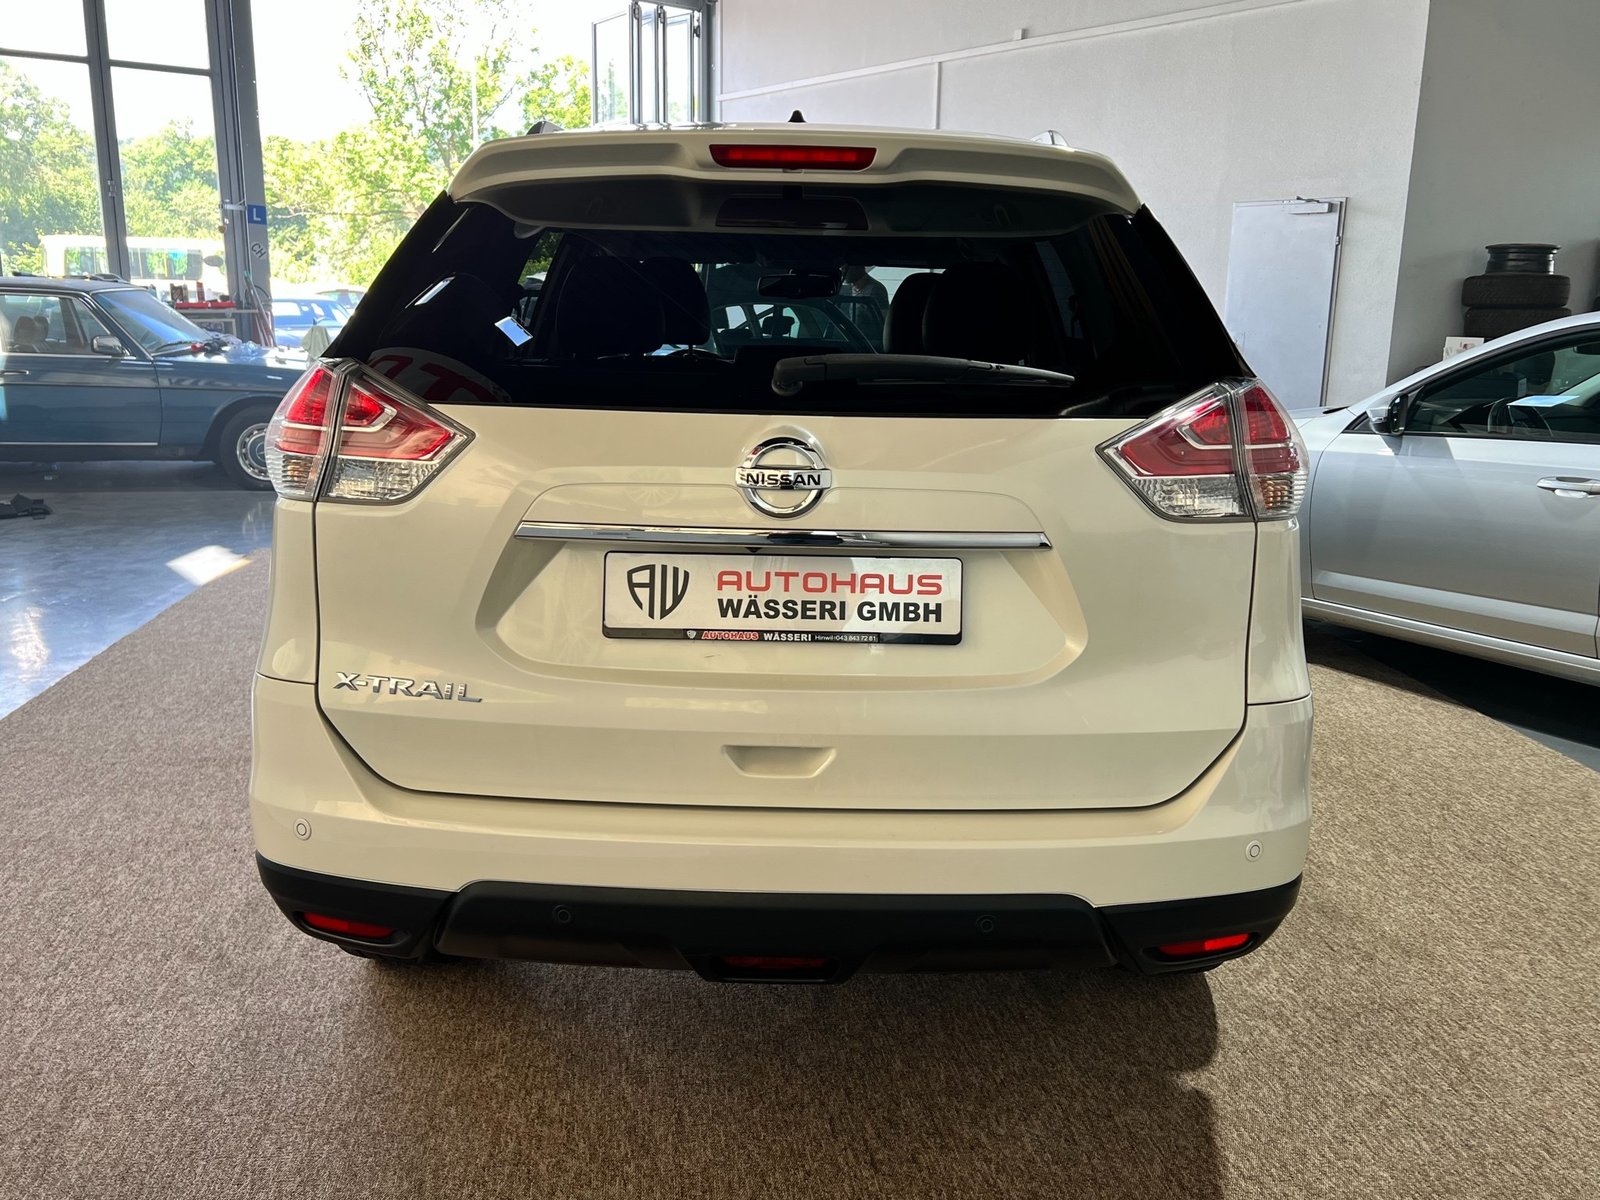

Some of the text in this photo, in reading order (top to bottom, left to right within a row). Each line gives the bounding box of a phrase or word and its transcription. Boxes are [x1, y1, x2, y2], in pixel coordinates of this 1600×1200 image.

[253, 207, 261, 221] L
[251, 242, 266, 258] CH
[746, 473, 820, 486] NISSAN
[717, 570, 943, 595] AUTOHAUS
[717, 595, 942, 623] WÄSSERI GMBH
[701, 630, 760, 641] AUTOHAUS
[763, 632, 812, 642] WÄSSERI
[333, 672, 482, 702] X-TRAIL
